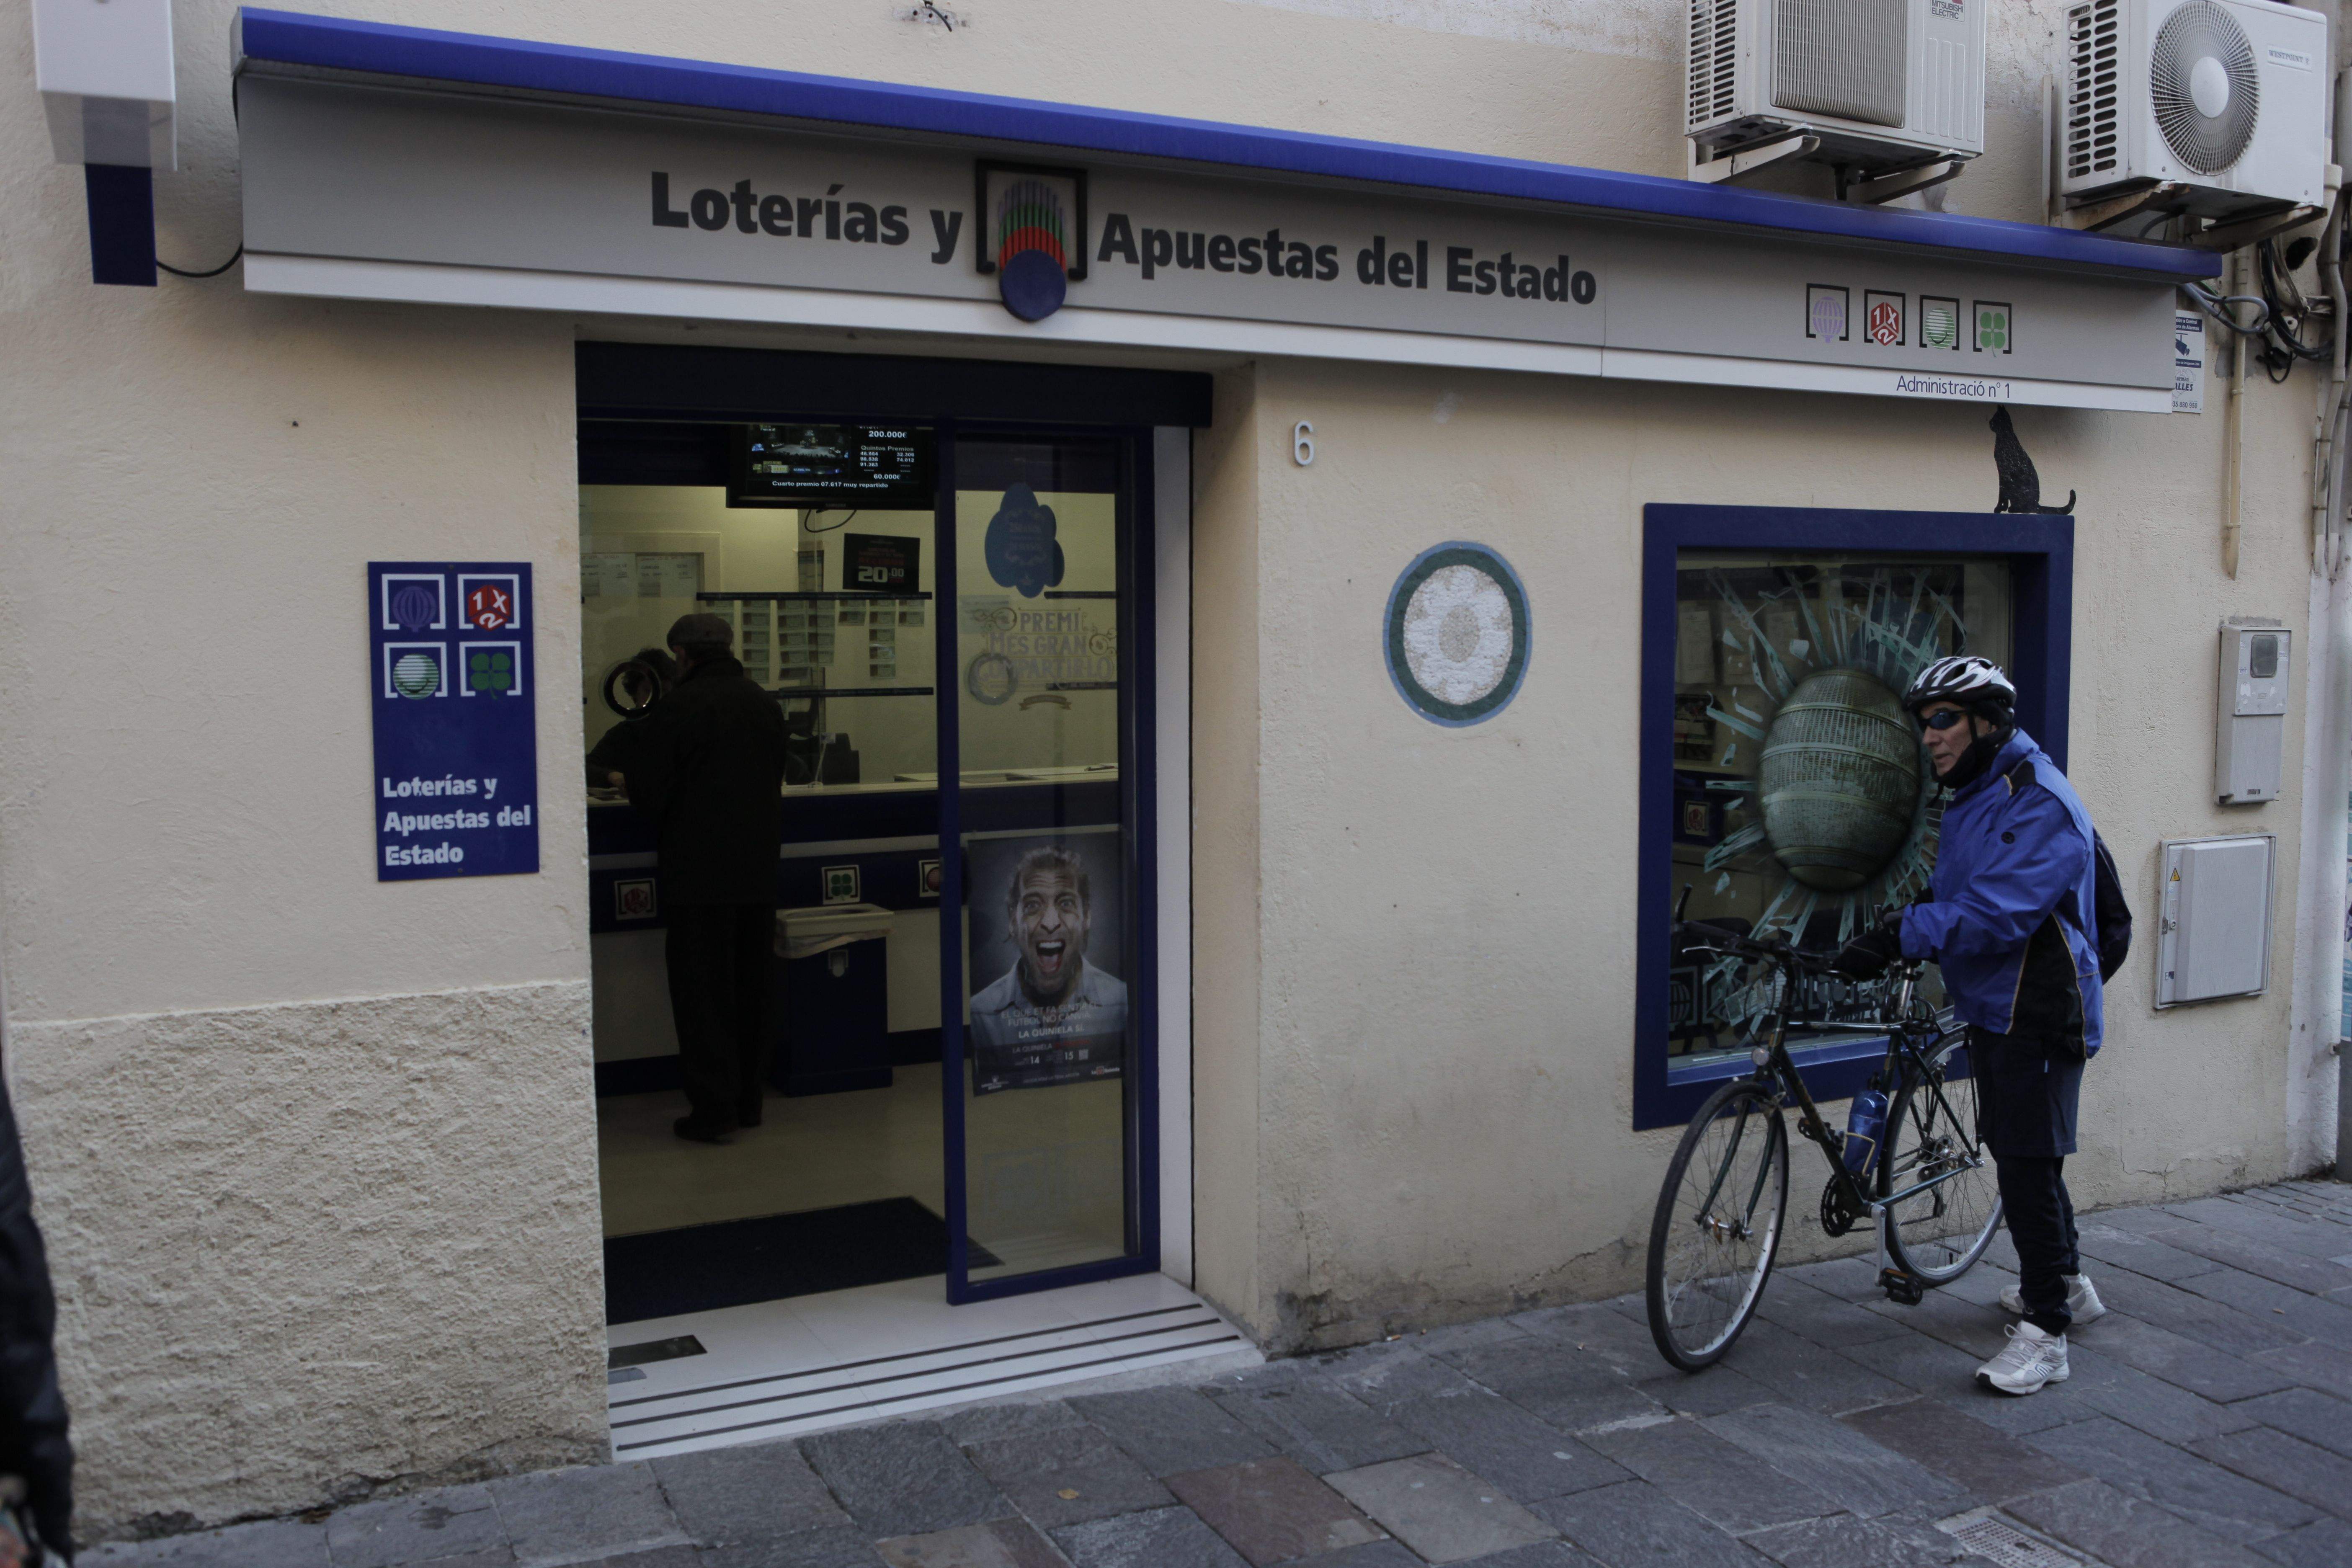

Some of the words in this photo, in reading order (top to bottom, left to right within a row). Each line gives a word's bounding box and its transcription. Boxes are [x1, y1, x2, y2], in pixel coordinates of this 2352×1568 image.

[1932, 0, 1963, 13] MITSUBISHI
[1932, 7, 1959, 19] ELECTRIC
[2268, 49, 2303, 63] WESTPOINT
[652, 172, 909, 246] Loterías
[930, 209, 963, 264] y
[1097, 213, 1339, 280] Apuestas
[1357, 236, 1428, 289] del
[1447, 246, 1596, 305] Estado
[1896, 375, 1985, 396] Administració
[2005, 383, 2010, 399] 1
[1295, 420, 1314, 465] 6
[1020, 612, 1079, 632] PREMI
[1034, 635, 1087, 655] GRAN
[383, 774, 477, 798] Loterías
[483, 778, 498, 800] y
[383, 809, 490, 837] Apuestas
[496, 805, 531, 827] del
[385, 841, 464, 866] Estado
[1046, 1006, 1057, 1014] FA
[1008, 1017, 1041, 1027] FUTBOL
[1042, 1014, 1057, 1023] NO
[1018, 1030, 1030, 1039] LA
[1032, 1025, 1073, 1037] QUINIELA
[1022, 1043, 1052, 1052] QUINIELA
[1030, 1055, 1040, 1065] 14
